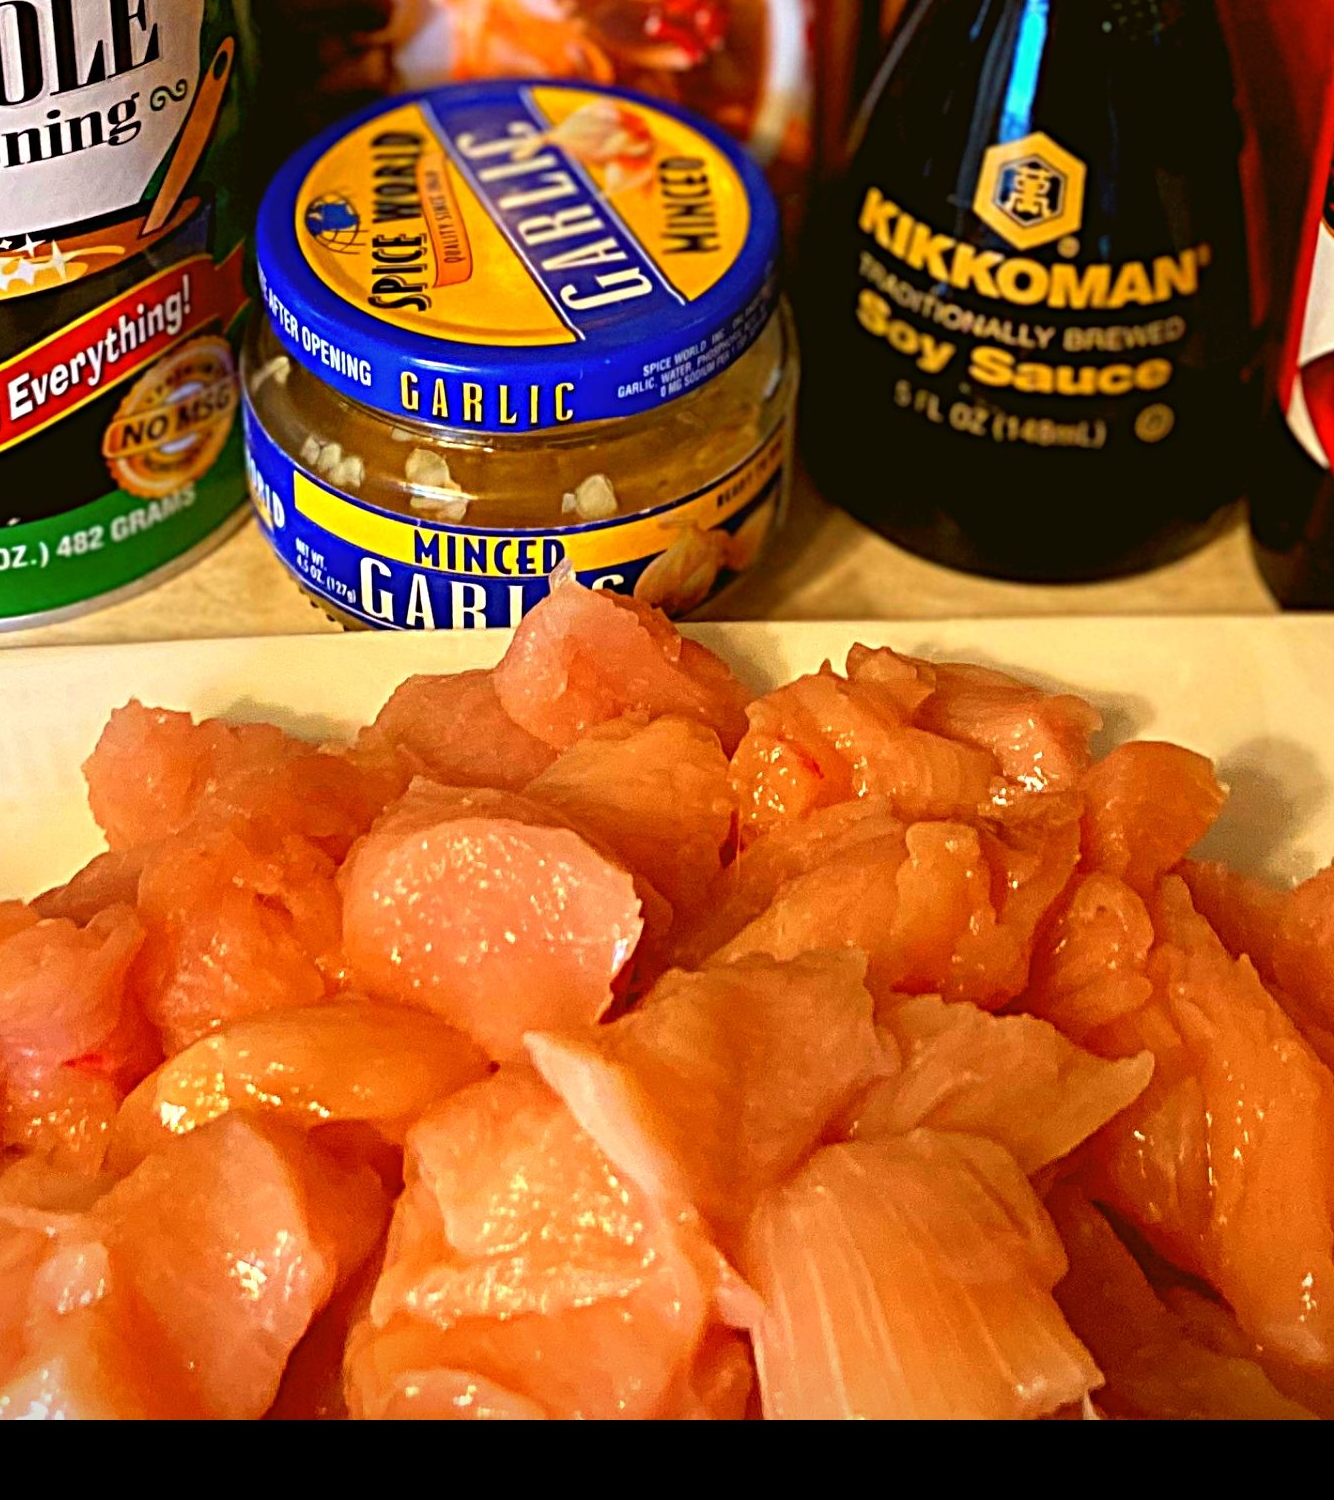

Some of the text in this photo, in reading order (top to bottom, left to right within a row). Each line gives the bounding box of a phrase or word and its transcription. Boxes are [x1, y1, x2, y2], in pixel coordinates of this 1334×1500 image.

[368, 132, 432, 313] SPICE WORLD
[456, 121, 653, 311] GARLIC
[659, 157, 721, 255] MINCED
[858, 187, 1201, 309] KIKKOMAN
[8, 276, 192, 422] Everything!
[268, 287, 372, 387] AFTER OPENING
[856, 289, 1173, 396] Soy Sauce
[859, 251, 1186, 352] TRADITIONALLY BREWED
[400, 371, 575, 425] GARLIC
[643, 357, 672, 377] SPICE
[914, 388, 944, 423] FL
[949, 402, 988, 437] OZ
[122, 415, 169, 448] NO
[56, 524, 105, 558] 482
[110, 485, 197, 539] GRAMS
[414, 529, 566, 575] MINCED
